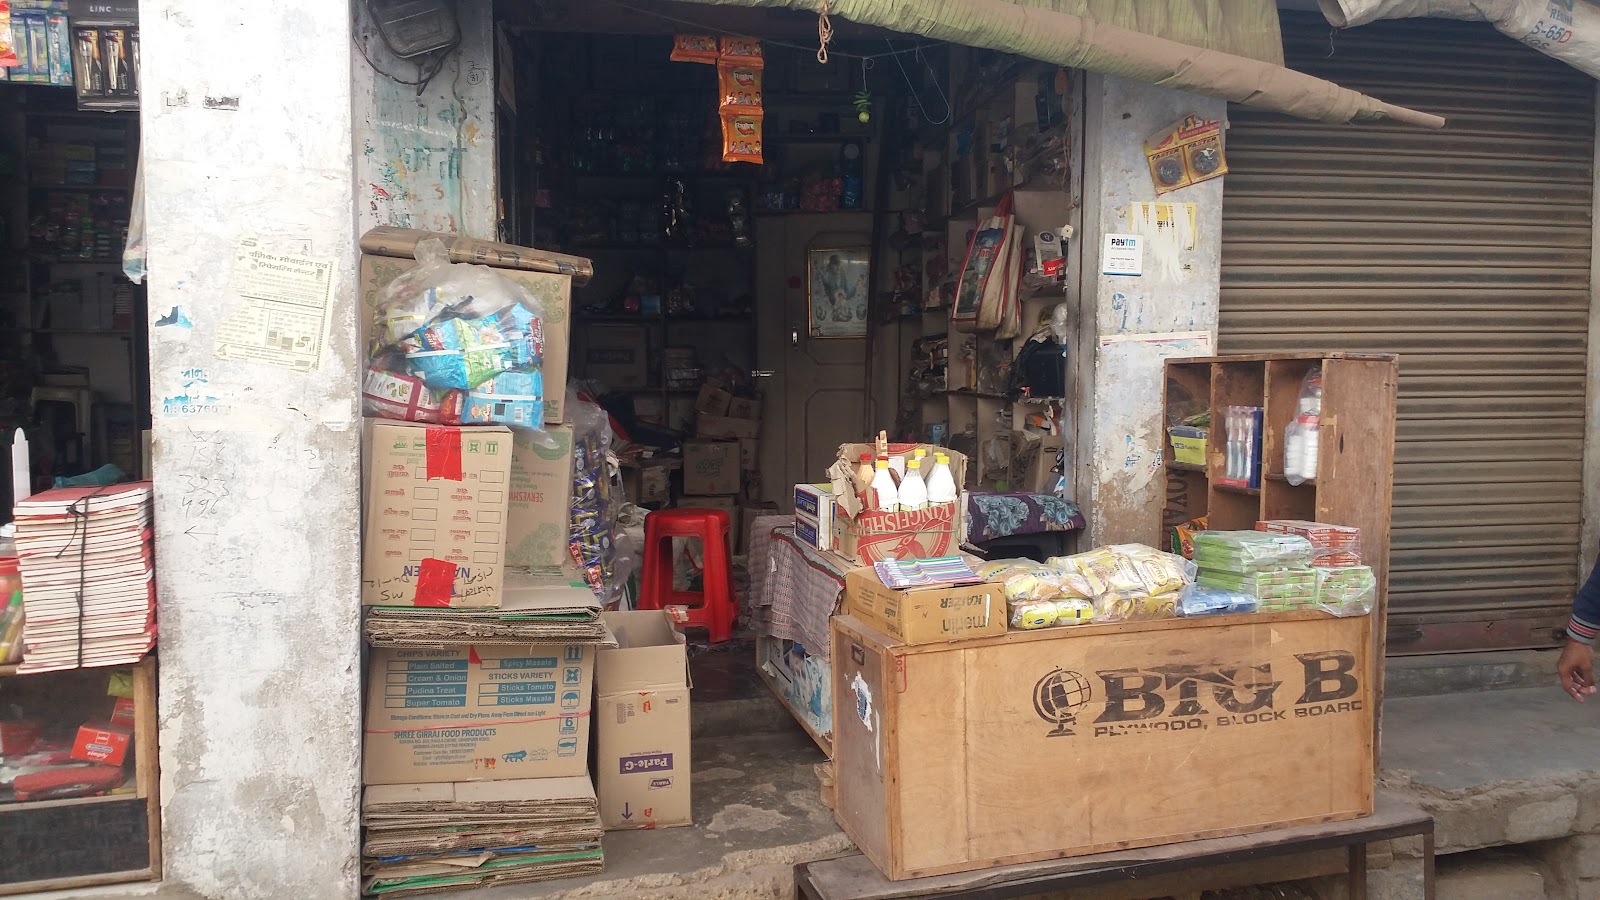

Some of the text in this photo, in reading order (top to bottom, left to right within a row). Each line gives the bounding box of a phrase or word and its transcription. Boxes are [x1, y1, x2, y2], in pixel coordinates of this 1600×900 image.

[1187, 136, 1217, 149] FASTER
[1151, 148, 1180, 161] FASTER
[397, 650, 461, 658] CHIPS VARIETY
[430, 661, 455, 669] Salted
[503, 658, 552, 668] Spicy Masala
[435, 674, 442, 682] &
[488, 671, 554, 681] STICKS VARIETY
[1294, 650, 1359, 705] B
[436, 686, 456, 694] Treat
[501, 683, 554, 692] Sticks Tomato
[406, 699, 460, 708] Super Tomato
[500, 695, 552, 704] Sticks Masala
[565, 717, 574, 727] 6
[1216, 709, 1285, 727] BLOCK
[393, 728, 497, 740] SHREE GIRRAJ FOOD PRODUCTS
[87, 751, 109, 759] simply
[624, 757, 668, 771] Parle-G
